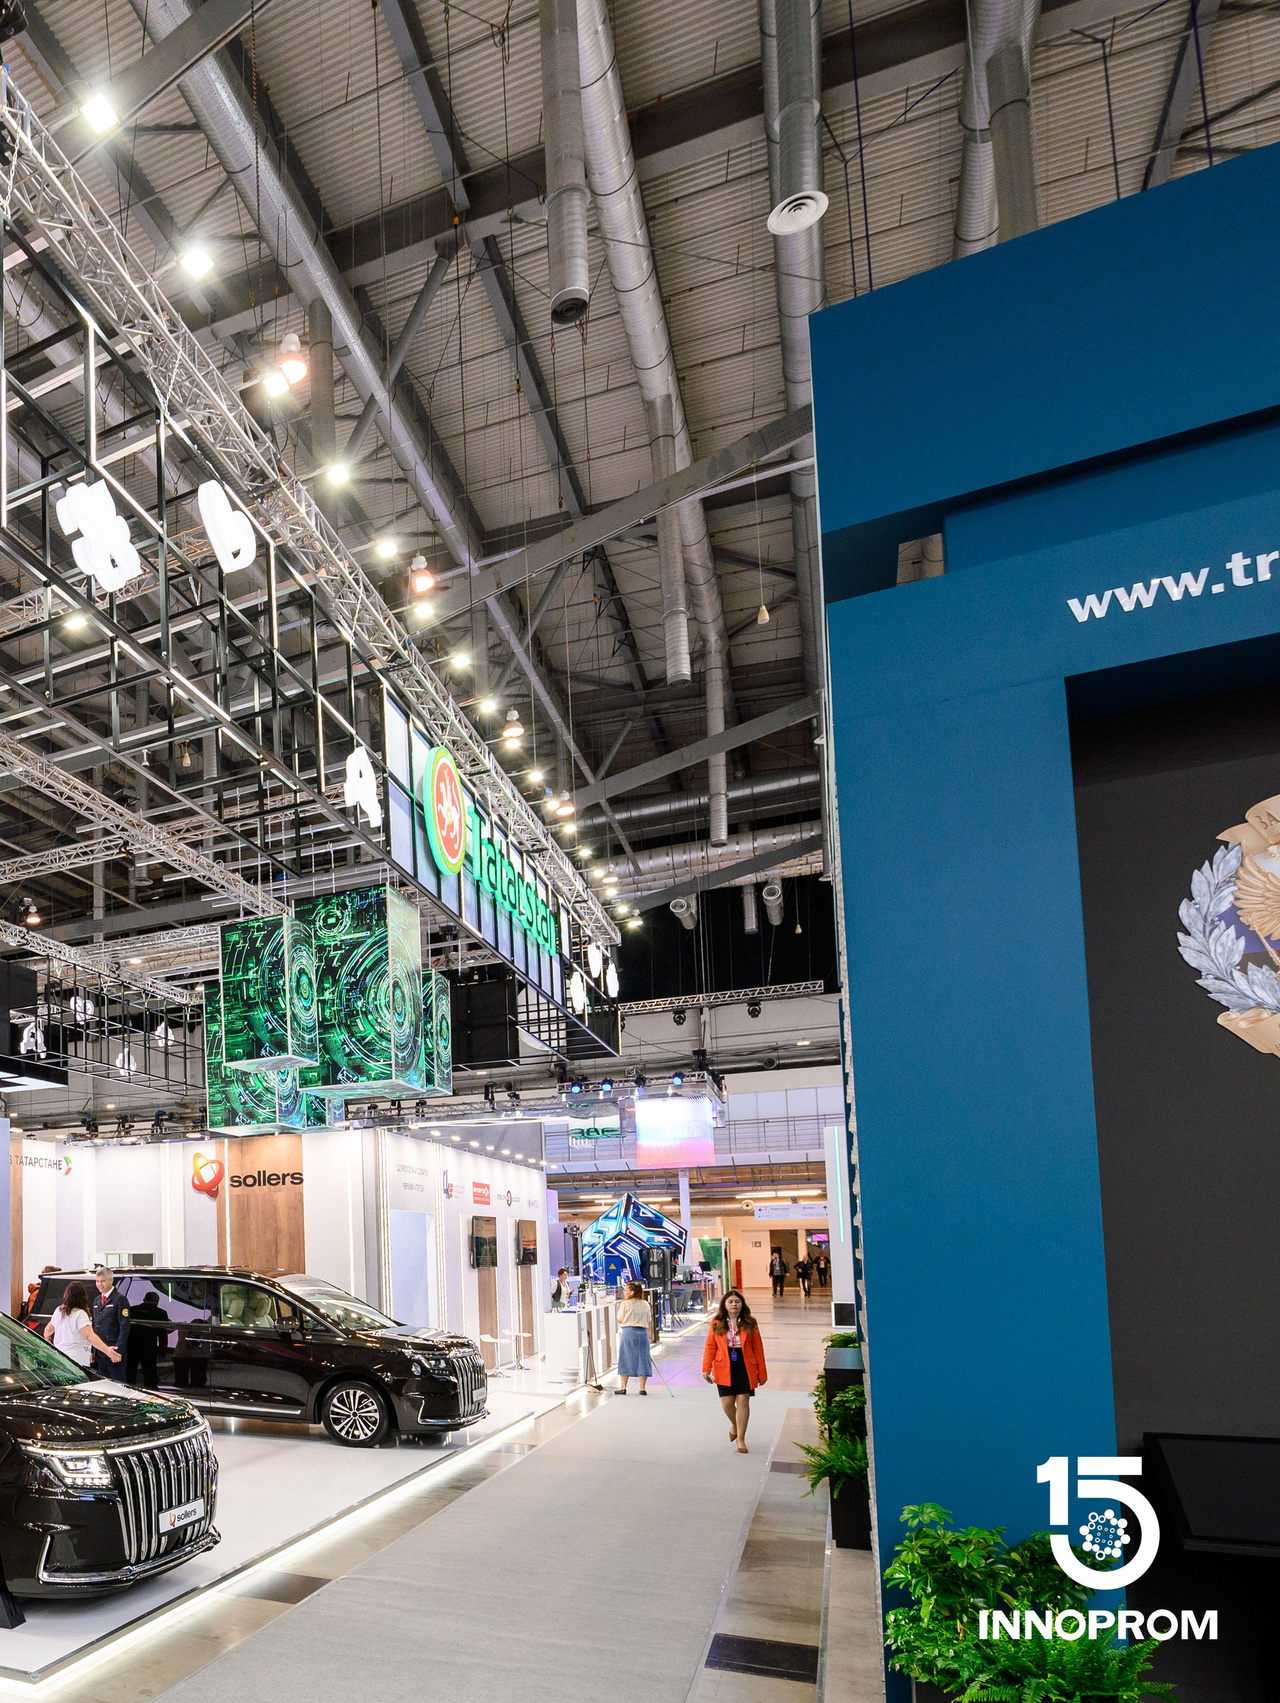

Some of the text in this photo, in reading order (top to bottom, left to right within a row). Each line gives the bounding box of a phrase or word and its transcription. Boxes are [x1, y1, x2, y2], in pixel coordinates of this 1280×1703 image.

[468, 804, 557, 956] Tatarstan
[15, 1155, 63, 1171] ТАТАРСТАНЕ
[229, 1170, 304, 1188] sollers
[177, 1508, 197, 1522] sollers
